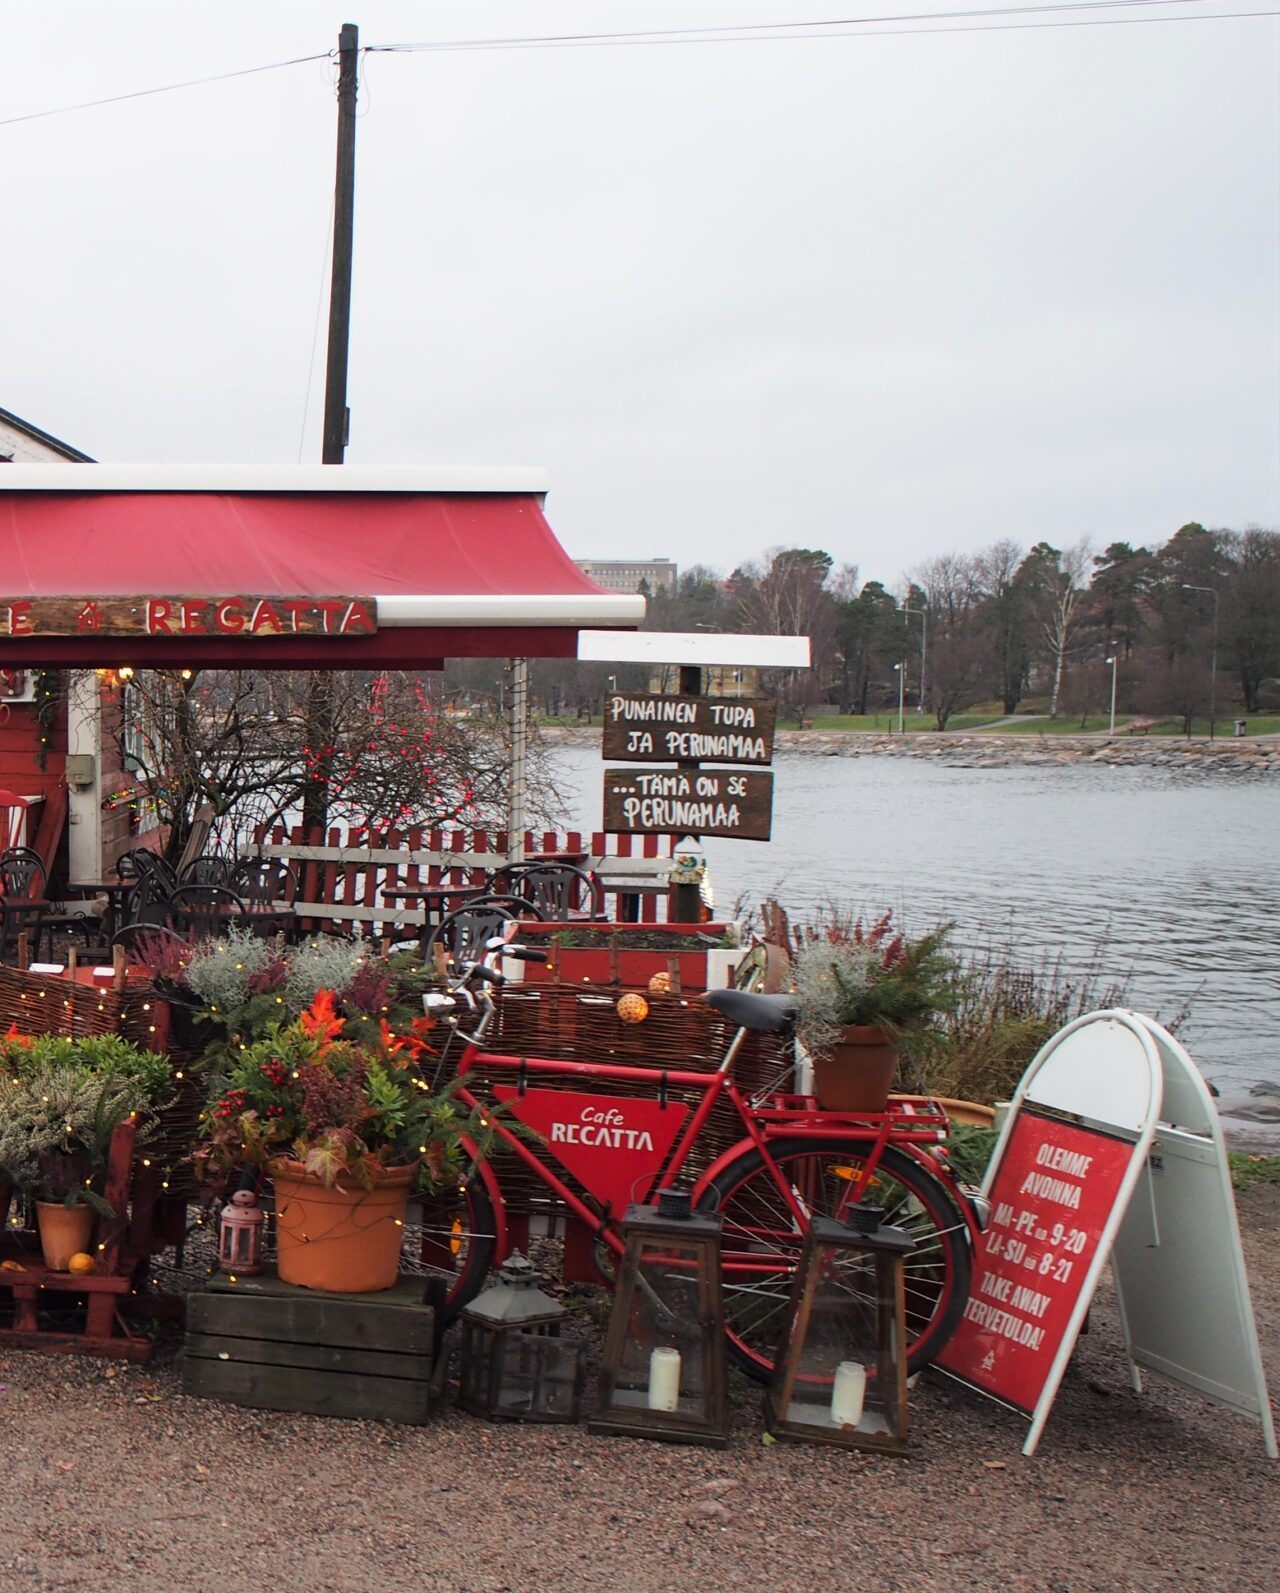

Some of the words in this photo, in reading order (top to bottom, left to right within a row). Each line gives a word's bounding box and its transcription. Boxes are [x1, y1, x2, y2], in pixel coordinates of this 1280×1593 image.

[146, 599, 375, 636] REGATTA
[611, 696, 697, 724] PUNAINEN
[710, 705, 756, 728] TUPA
[627, 731, 653, 753] JA
[665, 731, 766, 759] PERUNAMAA
[696, 776, 718, 796] ON
[727, 776, 748, 797] SE
[623, 797, 740, 828] PERUNAMAA
[581, 1106, 625, 1126] Cafe
[1036, 1143, 1093, 1179] OLEMME
[1022, 1171, 1083, 1210] AVOINNA
[993, 1202, 1039, 1237] MA-PE
[1050, 1222, 1088, 1255] 9-20
[985, 1231, 1028, 1265] LA-SU
[1038, 1252, 1074, 1284] 8-21
[980, 1271, 1013, 1303] TAKE
[1010, 1284, 1051, 1319] AWAY
[963, 1296, 1046, 1352] TERVETULOA!
